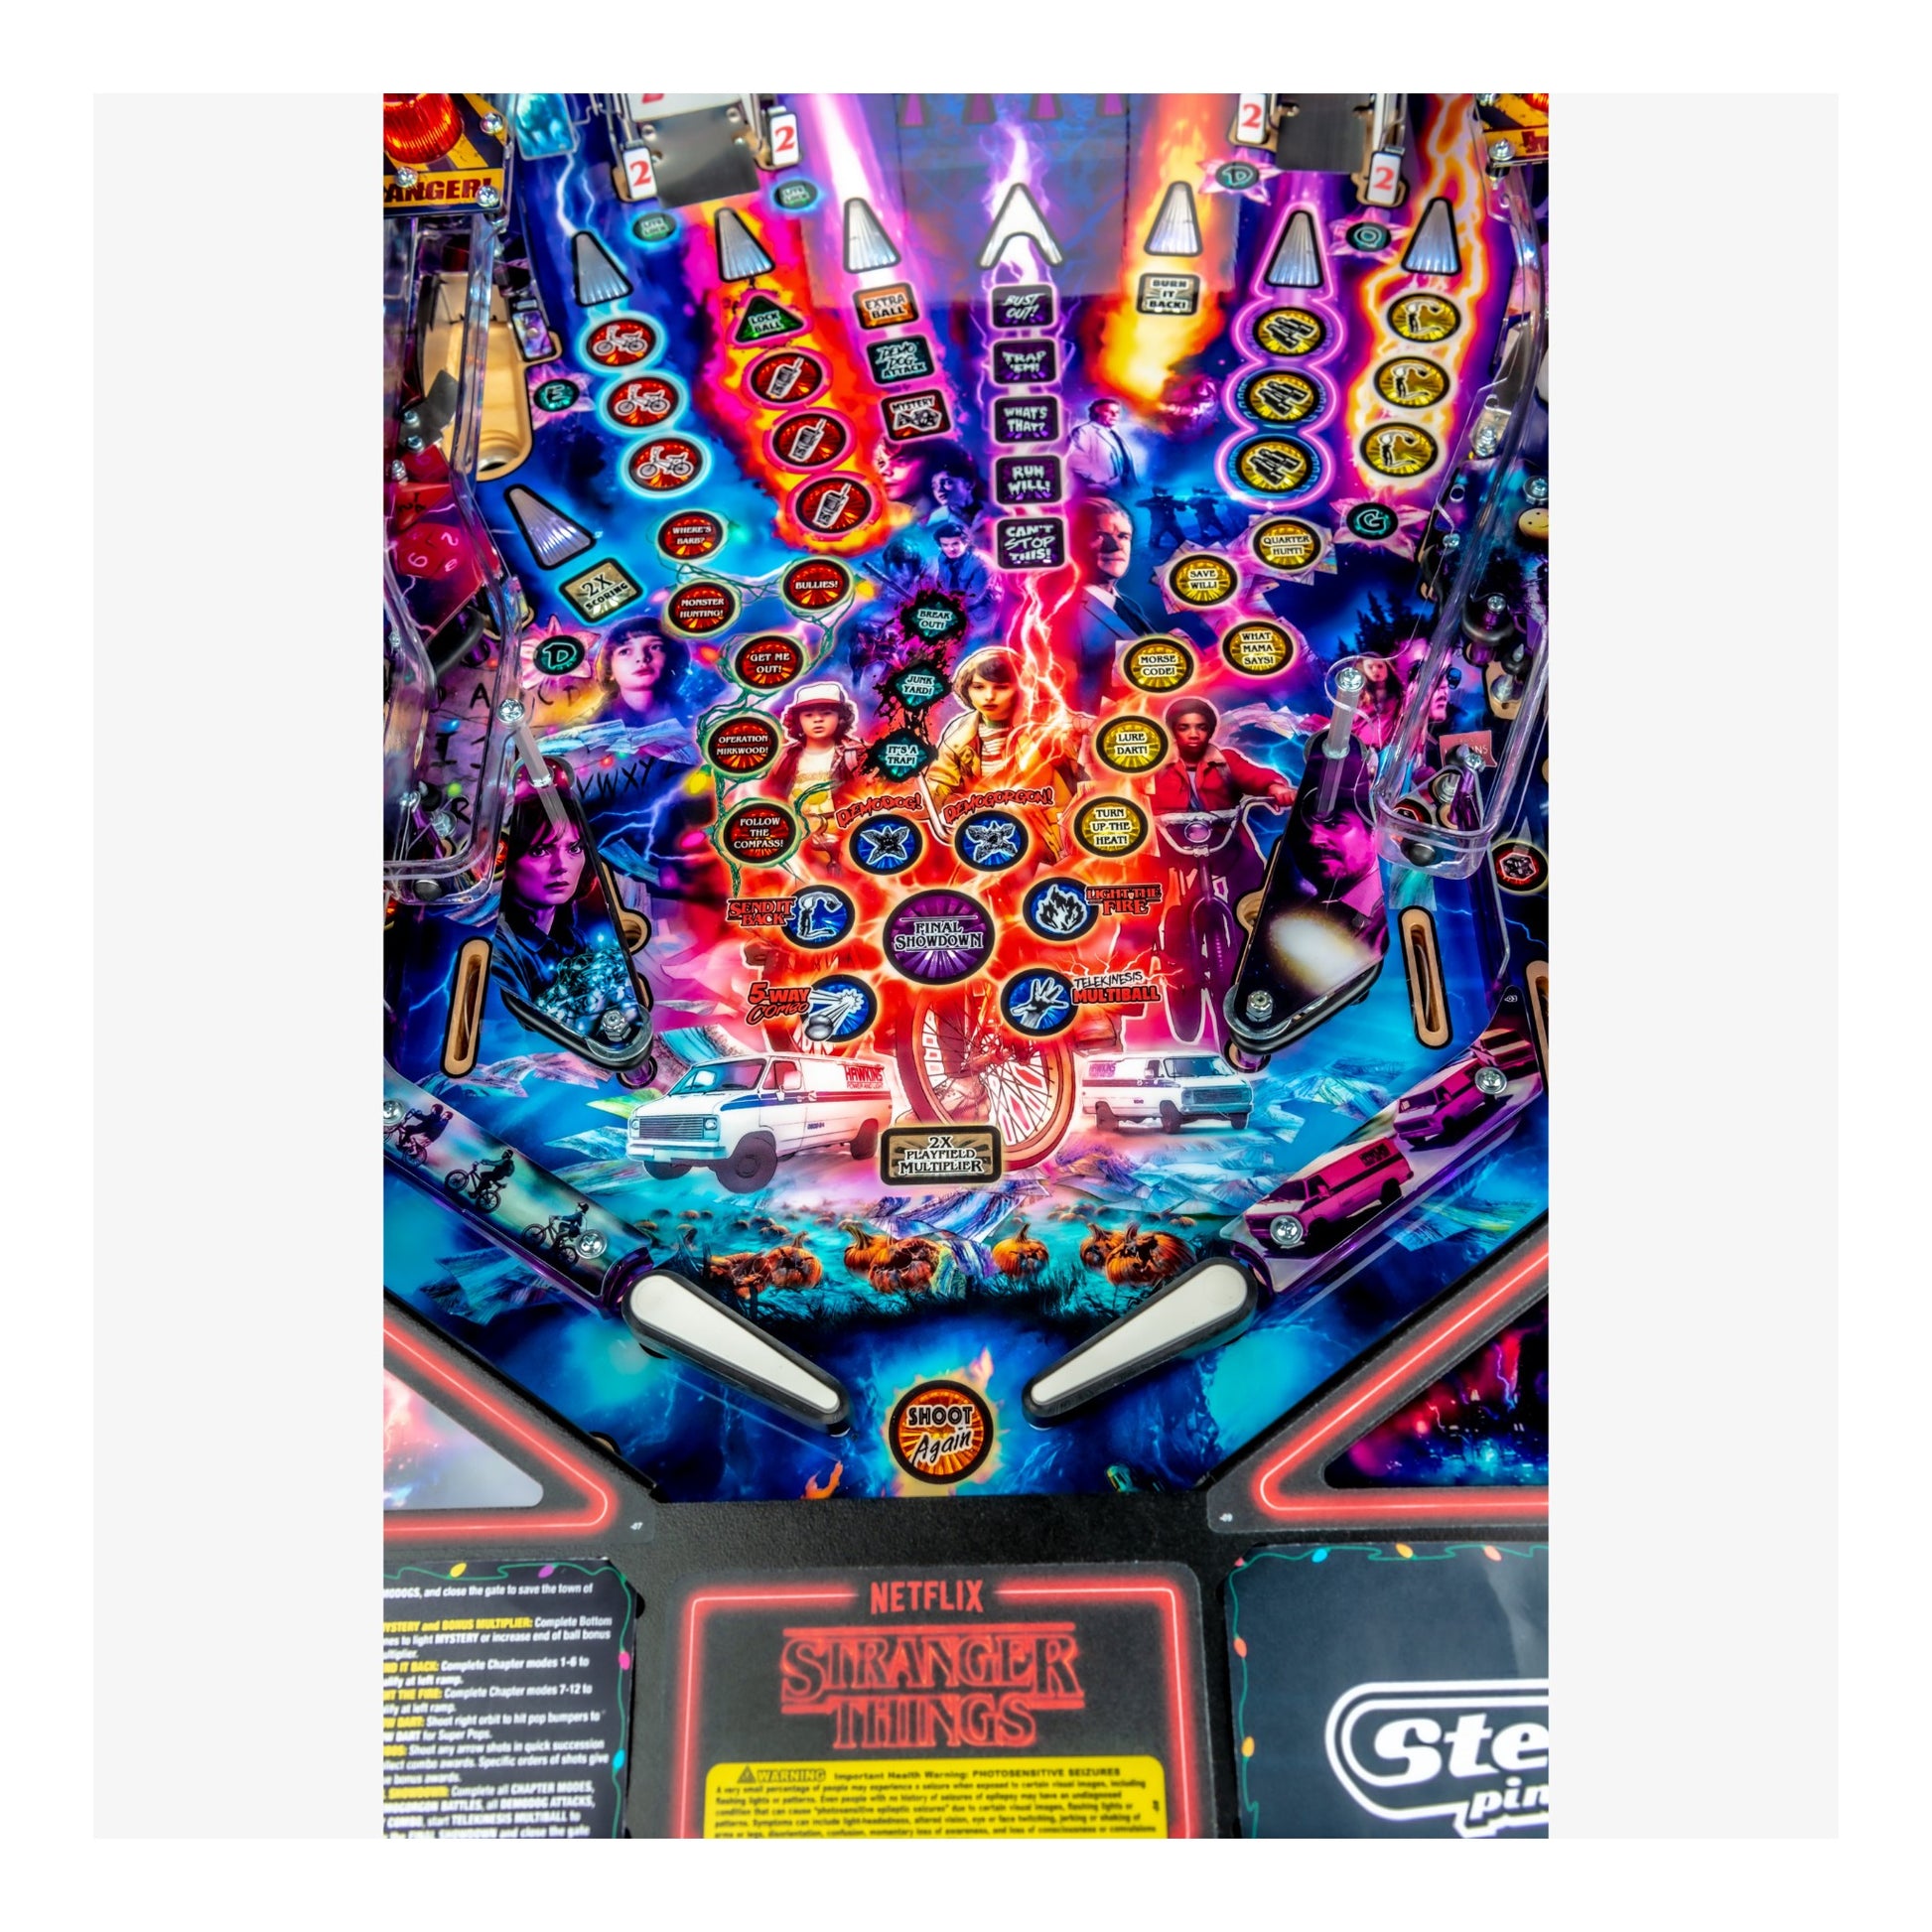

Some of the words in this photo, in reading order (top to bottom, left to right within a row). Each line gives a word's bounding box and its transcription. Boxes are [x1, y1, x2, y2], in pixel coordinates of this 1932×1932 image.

[1242, 104, 1262, 129] 2
[775, 126, 794, 153] 2
[629, 160, 652, 187] 2
[1222, 166, 1251, 187] D
[1373, 167, 1395, 191] 2
[1153, 279, 1187, 289] BURN
[1003, 293, 1045, 306] BUST
[1163, 290, 1174, 299] IT
[865, 294, 906, 311] EXTRA
[1149, 299, 1186, 310] BACK!
[752, 312, 779, 325] LOCK
[872, 306, 904, 320] BALL
[1007, 305, 1037, 319] OUT!
[754, 321, 782, 334] BALL
[1003, 351, 1046, 365] TRAP
[882, 361, 926, 379] ATTACK
[892, 396, 934, 413] MYSTERY
[1004, 406, 1047, 419] WHAT'S
[1007, 420, 1045, 433] THAT?
[1011, 465, 1044, 481] RUN
[1008, 480, 1050, 495] WILL!
[1357, 509, 1387, 534] G
[672, 524, 712, 535] WHERE'S
[1006, 525, 1053, 537] CAN'T
[676, 536, 706, 546] BARB?
[1004, 535, 1055, 550] STOP
[1263, 535, 1311, 546] QUARTER
[1009, 548, 1051, 561] THIS!
[1273, 546, 1304, 556] HUNT!
[1189, 569, 1217, 579] SAVE
[582, 572, 614, 599] 2X
[795, 580, 838, 590] BULLIES!
[1189, 581, 1218, 590] WILL!
[585, 582, 629, 612] SCORING
[681, 598, 725, 608] MONSTER
[679, 609, 724, 620] HUNTING!
[919, 610, 950, 621] BREAK
[920, 620, 945, 629] OUT!
[1241, 631, 1271, 642] WHAT
[1242, 643, 1273, 653] MAMA
[543, 642, 577, 669] D
[750, 653, 771, 662] GET
[774, 652, 790, 662] ME
[1140, 654, 1176, 664] MORSE
[1244, 655, 1274, 665] SAYS!
[756, 664, 782, 674] OUT!
[1142, 666, 1175, 676] CODE!
[907, 675, 933, 685] JUNK
[903, 685, 933, 696] YARD!
[718, 735, 768, 745] OPERATION
[1118, 733, 1146, 743] LURE
[716, 746, 769, 757] MIRKWOOD!
[888, 746, 908, 756] IT'S
[909, 745, 918, 755] A
[1116, 746, 1148, 756] DART!
[887, 756, 915, 765] TRAP!
[836, 794, 922, 828] DEMODOG!
[944, 788, 1053, 823] DEMOGORGON!
[1096, 808, 1125, 818] TURN
[740, 817, 781, 827] FOLLOW
[1092, 822, 1106, 832] UP
[1109, 822, 1131, 832] THE
[750, 828, 770, 838] THE
[734, 839, 784, 850] COMPASS!
[1095, 835, 1128, 845] HEAT!
[1086, 890, 1129, 899] LIGHT
[1134, 888, 1161, 897] THE
[730, 901, 774, 917] SEND
[776, 900, 793, 915] IT
[1103, 899, 1148, 915] FIRE
[742, 913, 785, 926] BACK
[915, 922, 961, 935] FINAL
[896, 932, 983, 951] SHOWDOWN
[1074, 971, 1143, 989] TELEKINESIS
[749, 982, 811, 1005] 5-WAY
[1073, 987, 1161, 1004] MULTIBALL
[844, 1065, 884, 1082] HAWKINS
[928, 1136, 952, 1149] 2X
[906, 1149, 976, 1161] PLAYFIELD
[899, 1160, 983, 1174] MULTIPLIER
[908, 1407, 973, 1426] SHOOT
[911, 1427, 972, 1465] Again
[871, 1580, 984, 1614] NETFLIX
[534, 1616, 578, 1629] Complete
[579, 1615, 613, 1627] Bottom
[781, 1634, 1084, 1701] STRANGER
[833, 1693, 1037, 1749] THINGS
[758, 1769, 826, 1783] WARNING
[834, 1771, 885, 1782] Important
[888, 1771, 920, 1780] Health
[924, 1771, 968, 1780] Warning:
[972, 1768, 1064, 1778] PHOTOSENSITIVE
[1068, 1767, 1121, 1777] SEIZURES
